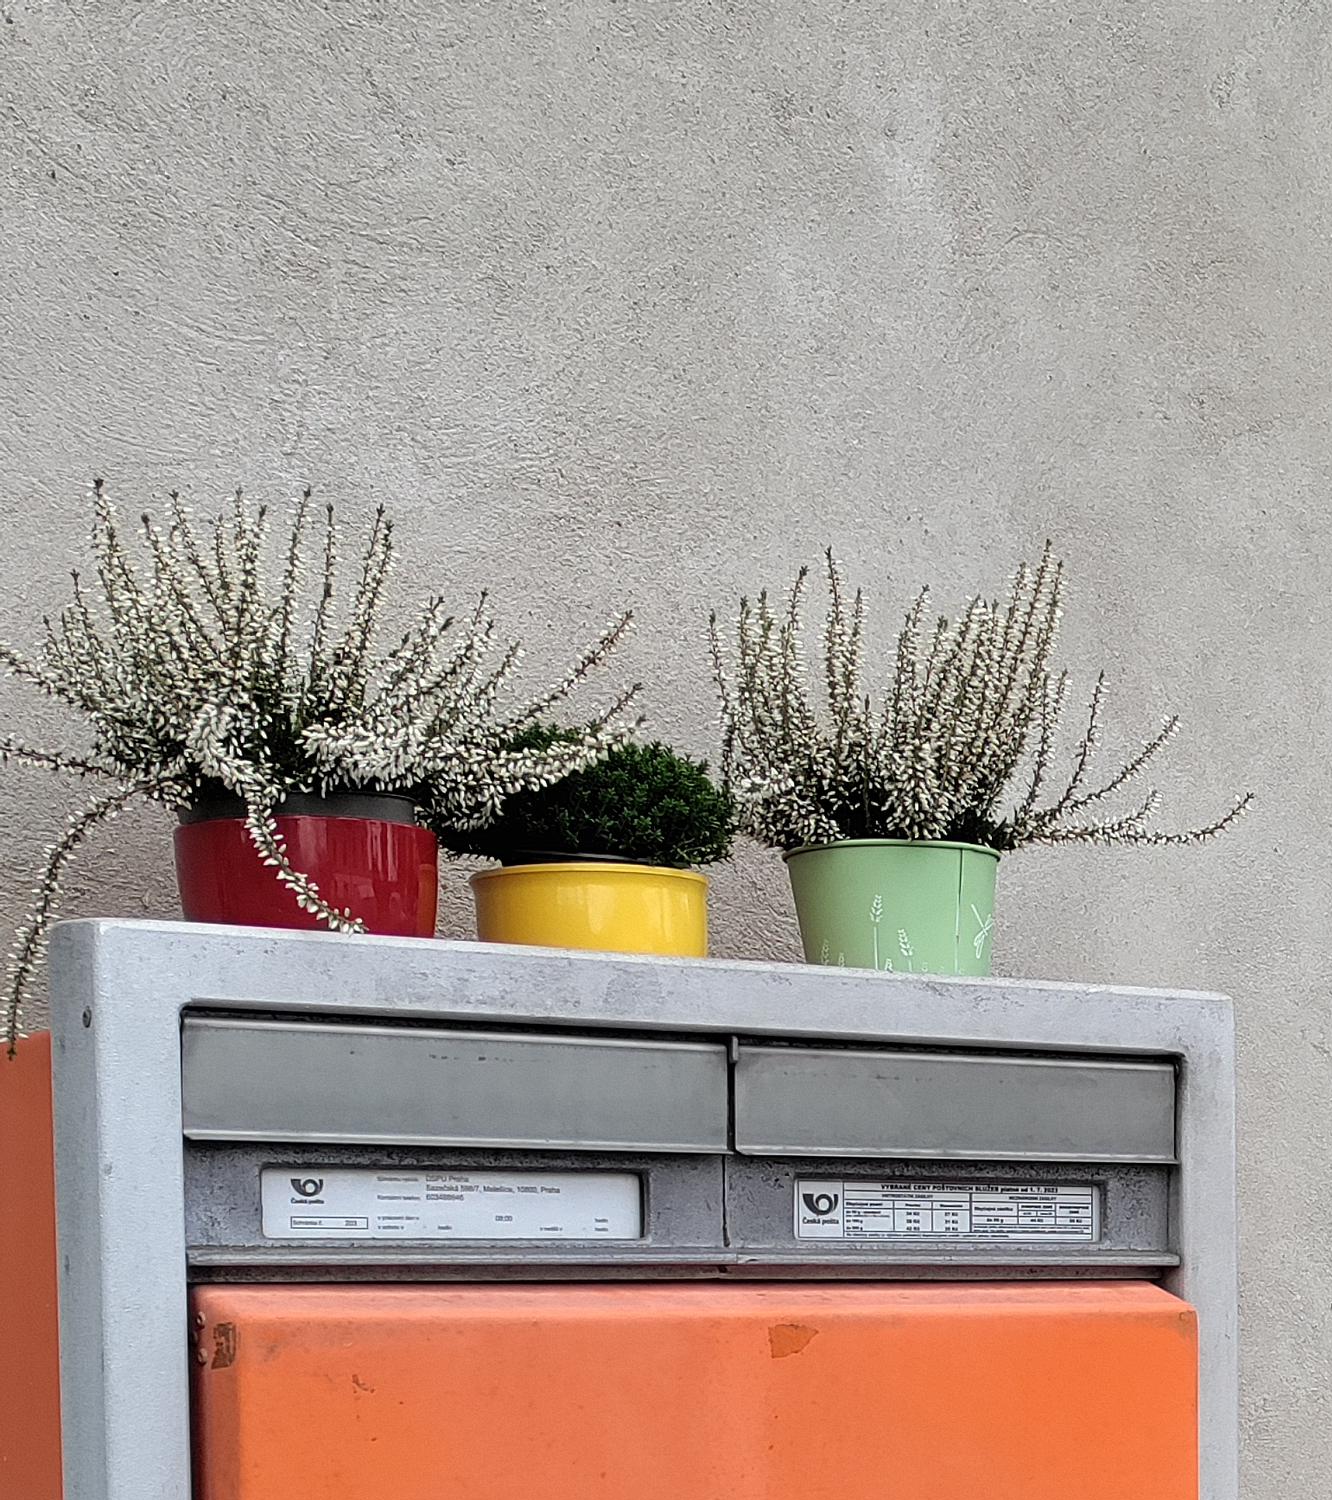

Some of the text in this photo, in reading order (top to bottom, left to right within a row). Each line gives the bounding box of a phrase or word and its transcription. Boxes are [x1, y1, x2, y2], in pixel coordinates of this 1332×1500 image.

[974, 1184, 999, 1192] SLUŽEB
[802, 1217, 840, 1227] Česká pošta
